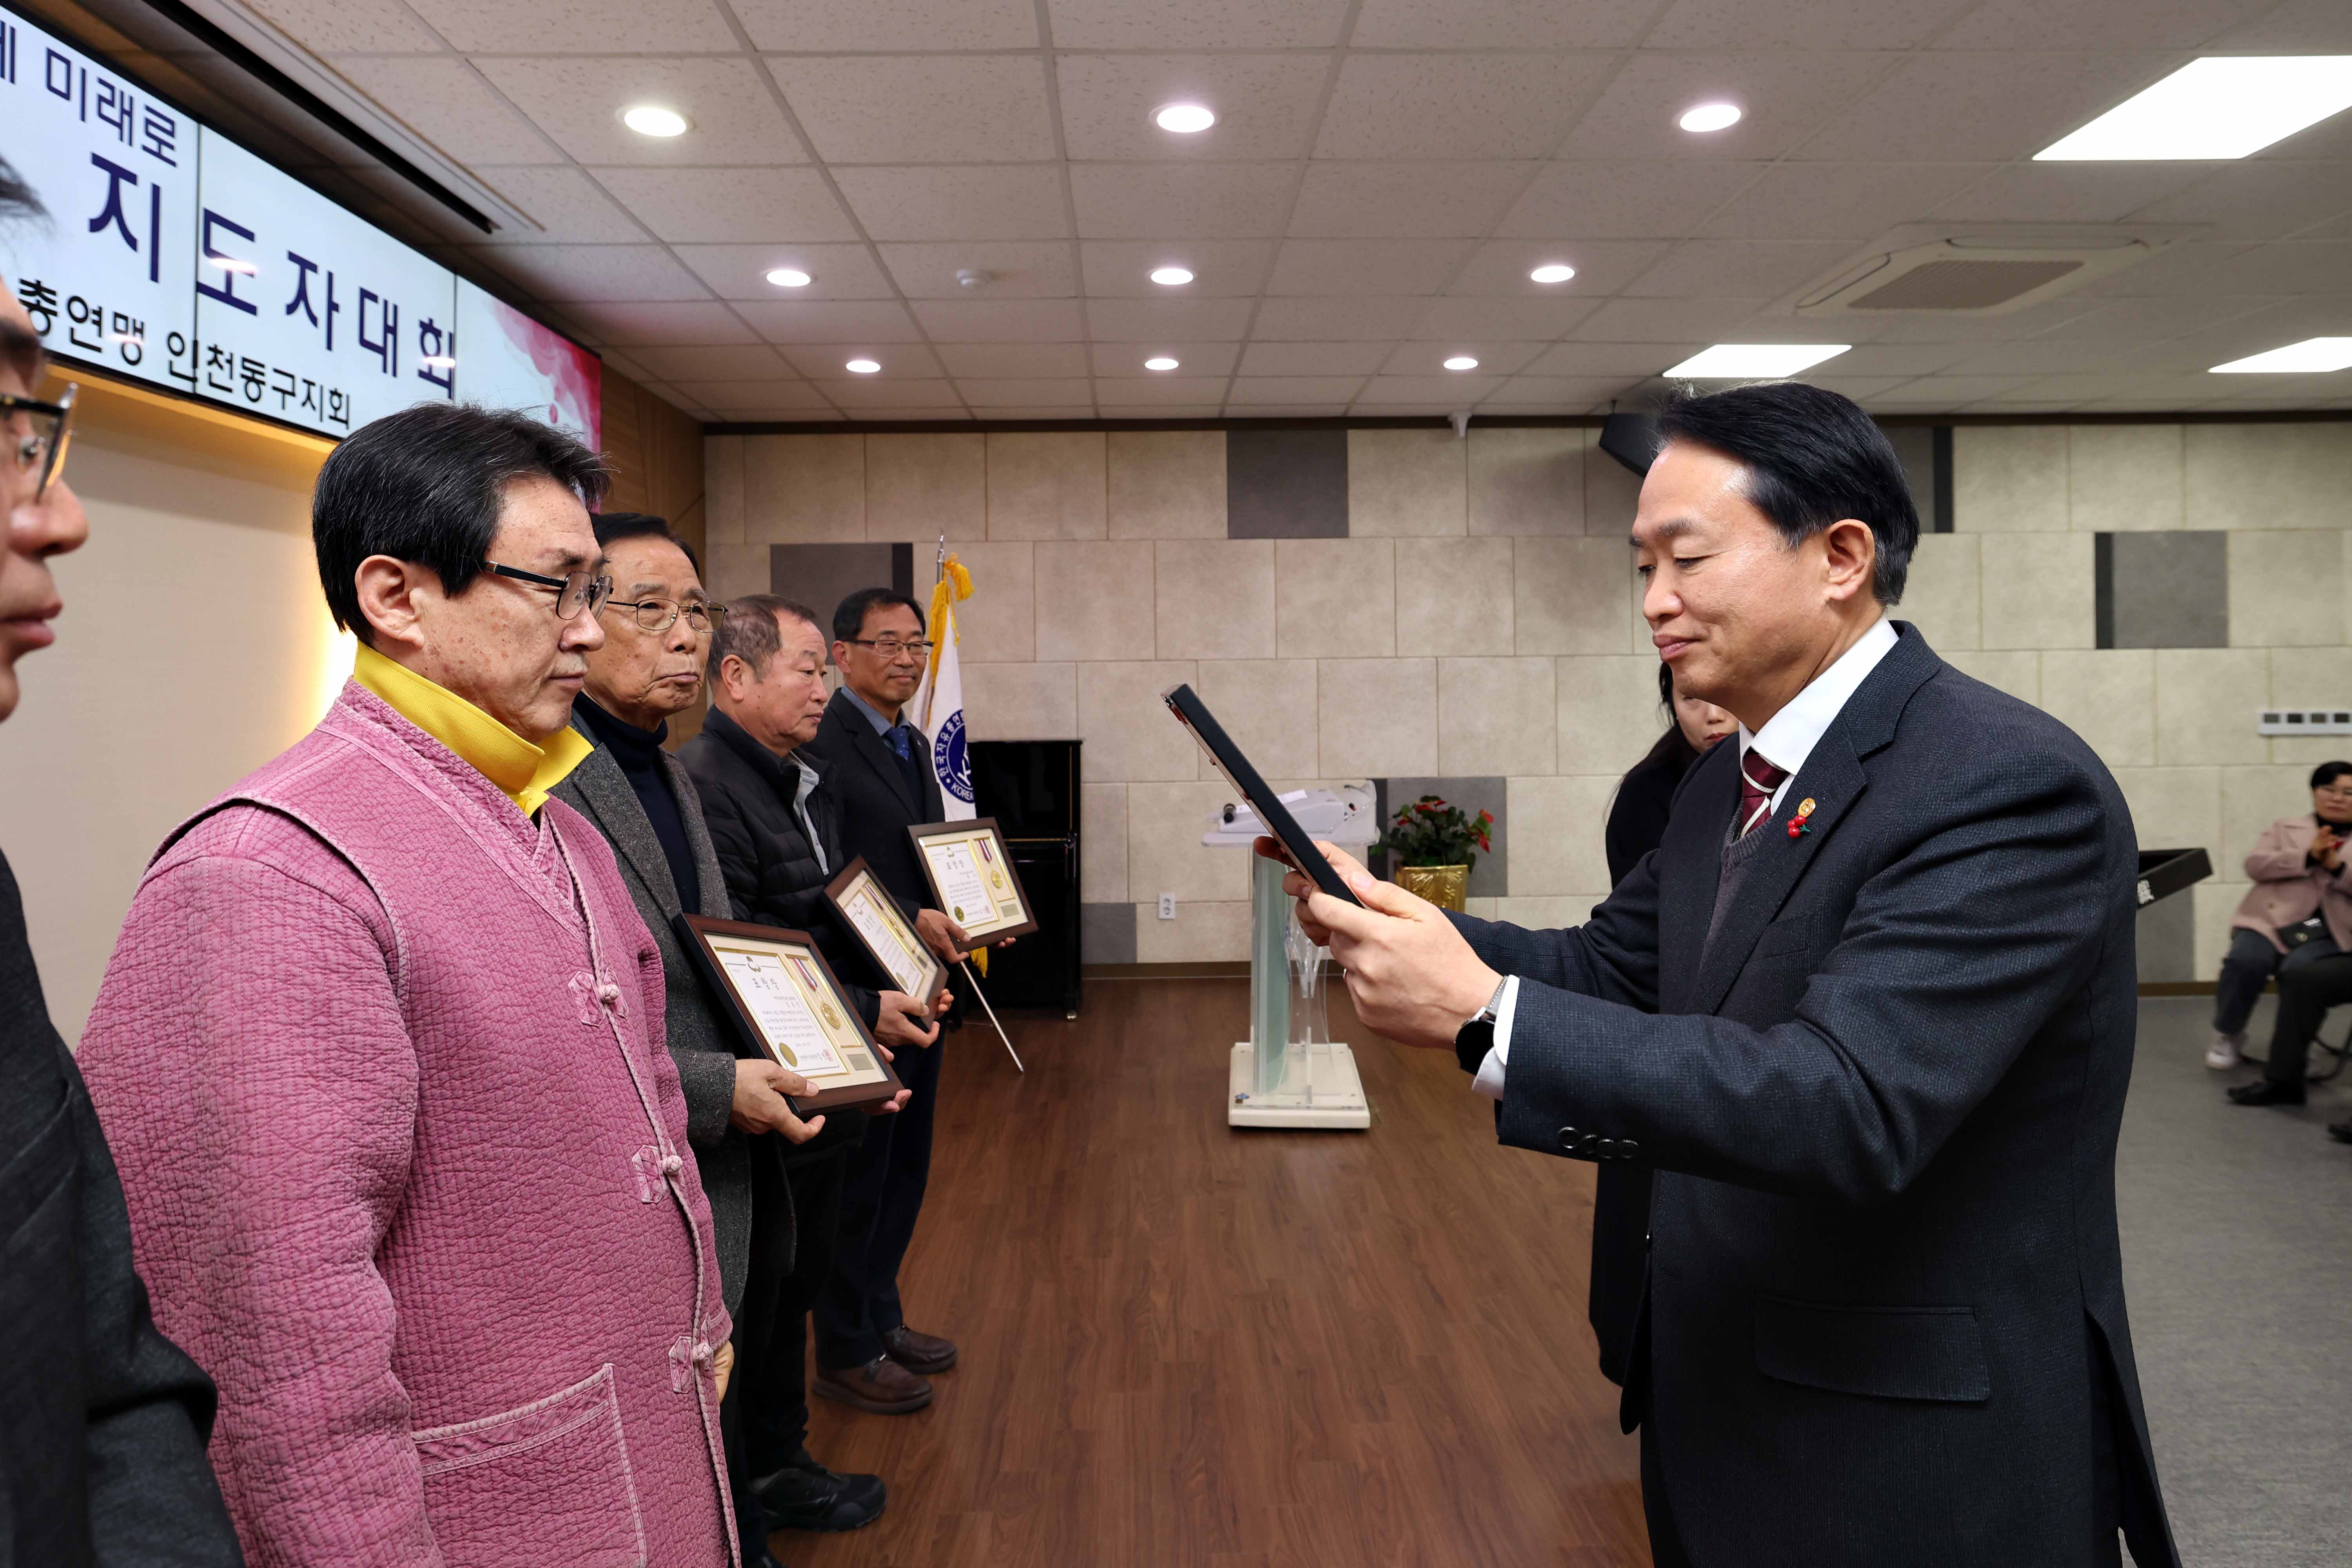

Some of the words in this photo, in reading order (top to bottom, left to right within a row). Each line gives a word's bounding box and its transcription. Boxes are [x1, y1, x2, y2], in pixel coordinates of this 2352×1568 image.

[46, 47, 177, 168] 미래로
[88, 152, 454, 399] 지도자대회
[18, 278, 145, 366] 총연맹
[167, 332, 350, 430] 인천동구지회
[936, 711, 964, 778] 한국자유총연
